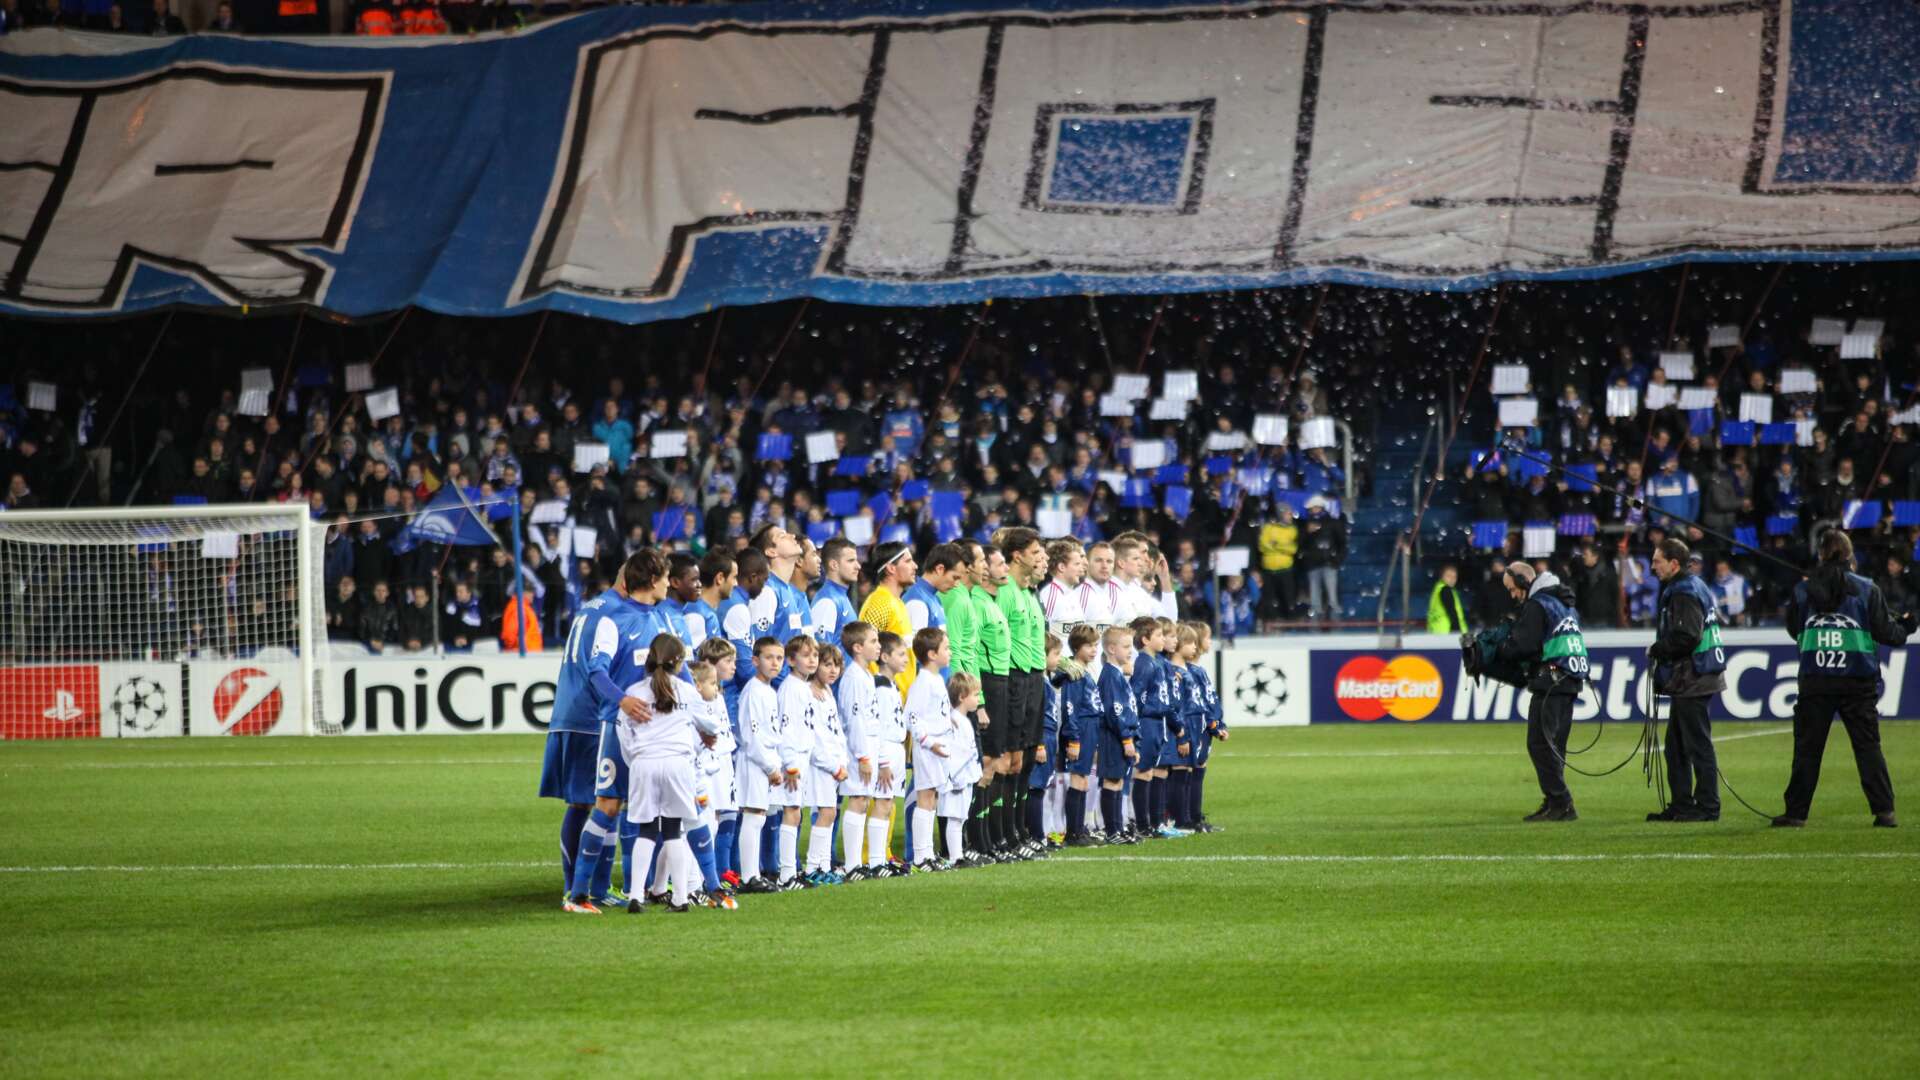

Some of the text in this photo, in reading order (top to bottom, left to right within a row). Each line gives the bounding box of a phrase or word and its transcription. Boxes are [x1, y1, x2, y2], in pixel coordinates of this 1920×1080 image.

[563, 614, 588, 664] 11
[1567, 637, 1583, 653] HB
[1817, 631, 1844, 648] HB
[1815, 650, 1847, 668] 022
[1337, 678, 1439, 699] MasterCard
[1452, 650, 1907, 720] MsteCad
[312, 665, 557, 734] UniCre
[596, 757, 617, 790] 9
